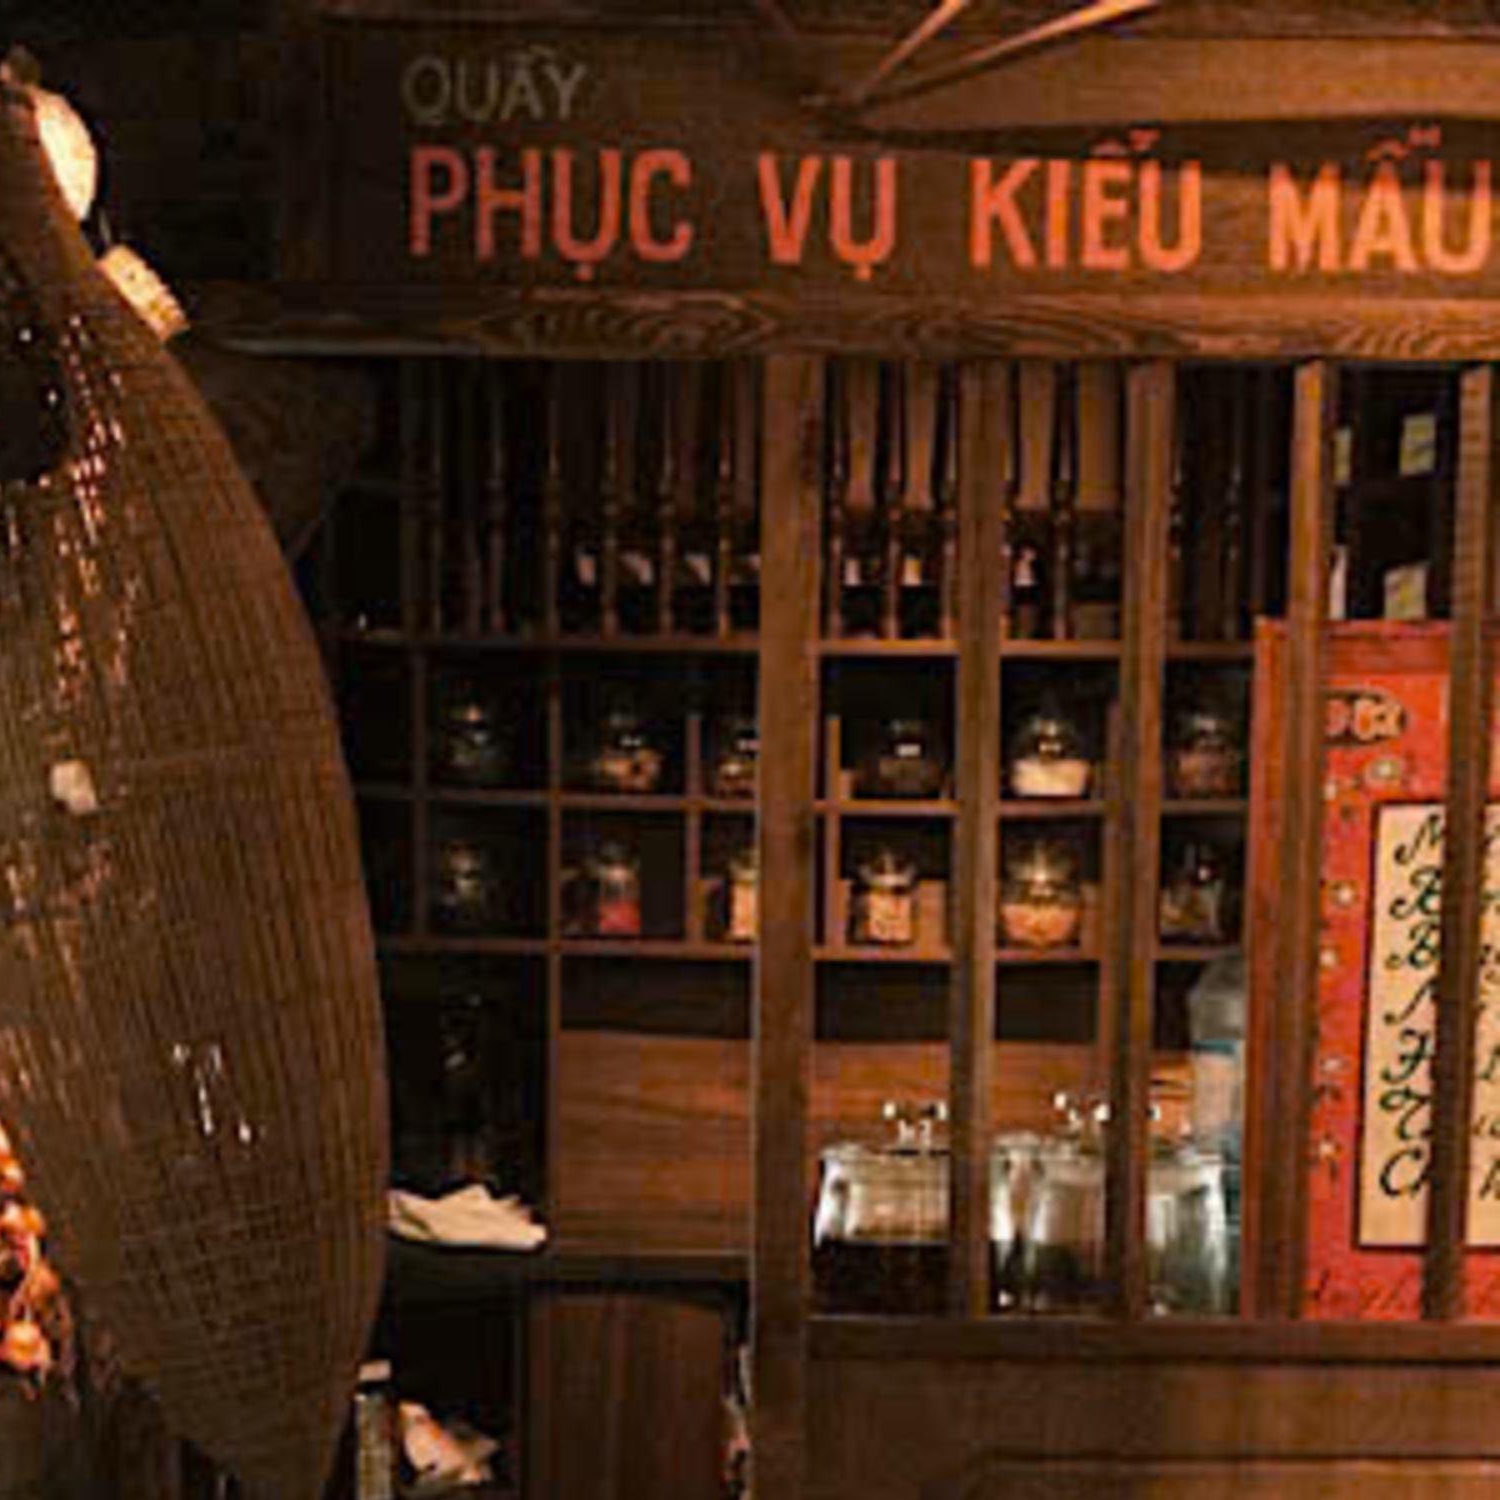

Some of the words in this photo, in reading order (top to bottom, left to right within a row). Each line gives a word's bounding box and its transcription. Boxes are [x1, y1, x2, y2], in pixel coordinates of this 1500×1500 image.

[408, 147, 694, 281] PHỤC
[758, 151, 897, 282] VỤ
[968, 128, 1201, 271] KIỂU
